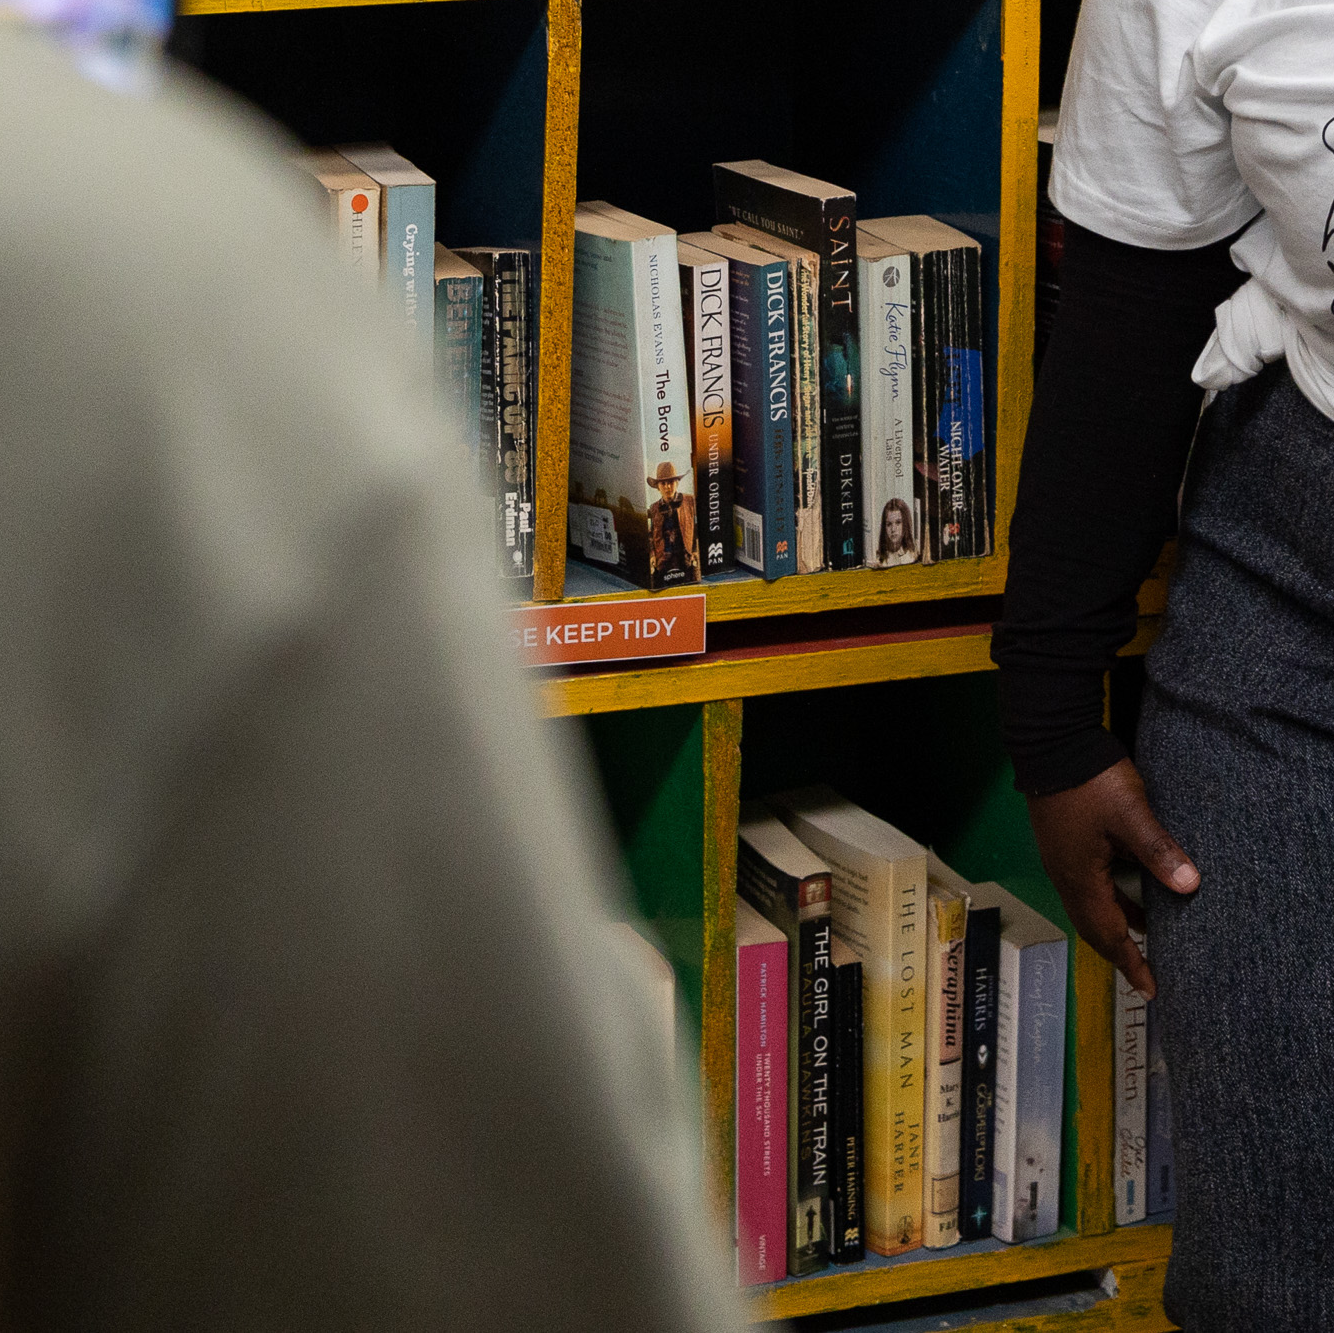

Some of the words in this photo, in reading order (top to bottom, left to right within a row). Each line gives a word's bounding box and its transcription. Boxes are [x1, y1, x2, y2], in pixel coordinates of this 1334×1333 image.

[649, 254, 661, 320] NICHOLAS
[829, 216, 854, 314] SAINT
[701, 269, 722, 332] DICK
[767, 270, 785, 326] DICK
[885, 302, 909, 343] Katie
[654, 323, 664, 366] EVANS
[655, 369, 671, 401] The
[703, 336, 725, 429] FRANCIS
[769, 330, 788, 422] FRANCIS
[881, 344, 907, 402] Flynn
[657, 404, 671, 452] Brave
[709, 434, 719, 478] UNDER
[885, 438, 893, 462] Lass
[839, 454, 854, 524] DEKKER
[939, 444, 951, 492] WATER
[505, 492, 517, 548] Erdman
[709, 482, 721, 532] ORDERS
[546, 622, 613, 646] KEEP
[619, 616, 677, 640] TIDY
[901, 884, 916, 934] THE
[814, 926, 829, 968] THE
[801, 962, 812, 1039] PAULA
[814, 978, 829, 1029] GIRL
[899, 950, 915, 1014] LOST
[944, 939, 962, 1048] Seraphina
[975, 966, 987, 1032] HARRIS
[813, 1035, 828, 1066] ON
[900, 1031, 913, 1089] MAN
[801, 1051, 811, 1162] HAWKINS
[813, 1074, 827, 1118] THE
[813, 1122, 827, 1186] TRAIN
[894, 1112, 905, 1194] HARPER
[909, 1122, 920, 1174] JANE
